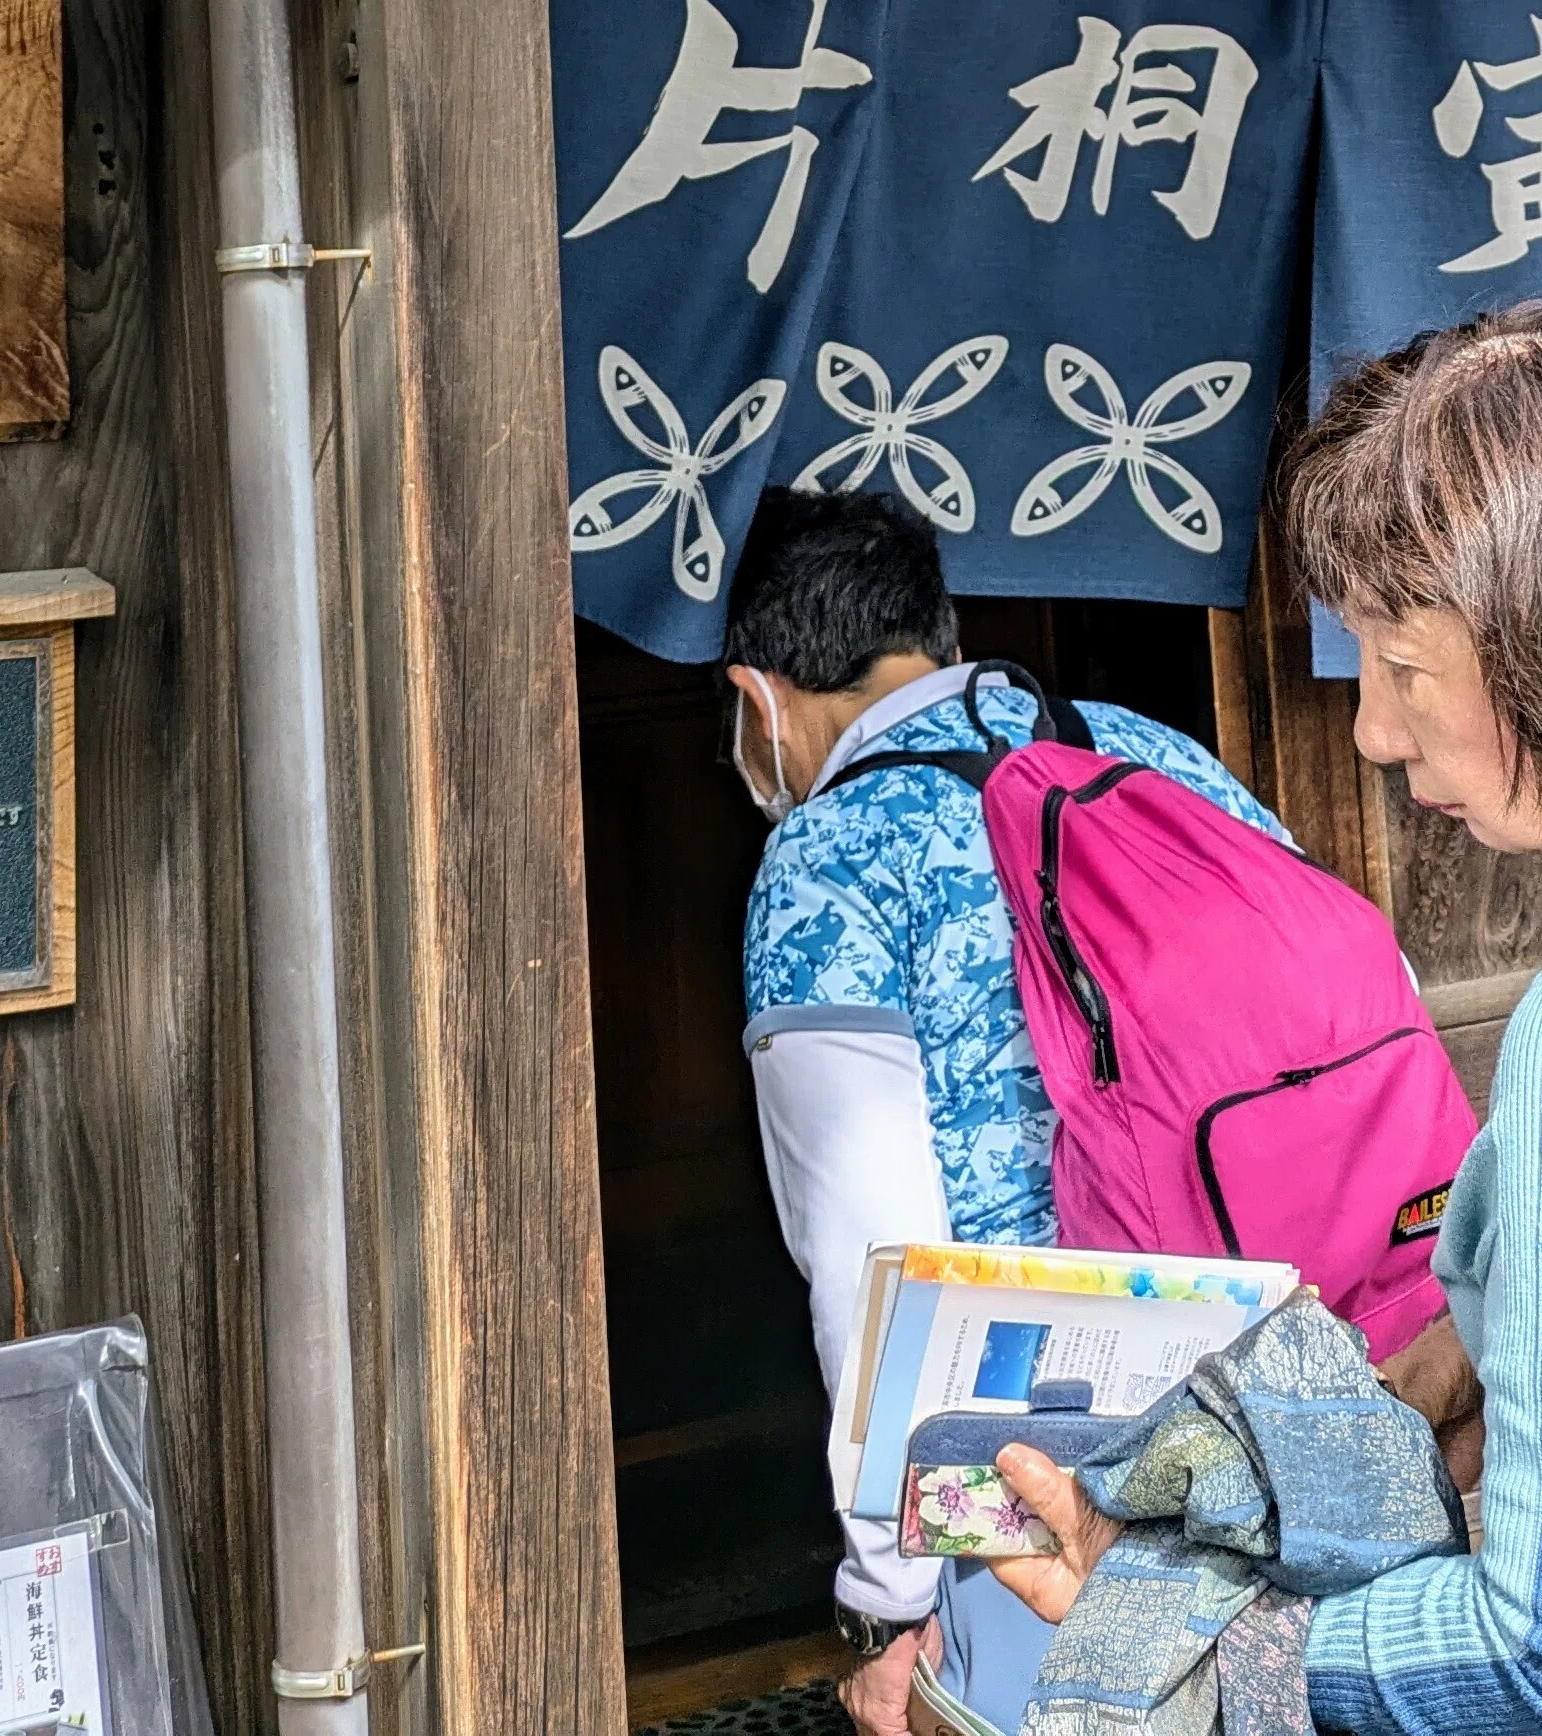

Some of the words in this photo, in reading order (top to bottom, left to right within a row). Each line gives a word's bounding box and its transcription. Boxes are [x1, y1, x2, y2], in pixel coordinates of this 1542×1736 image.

[25, 1580, 49, 1684] 海鮮丼定食
